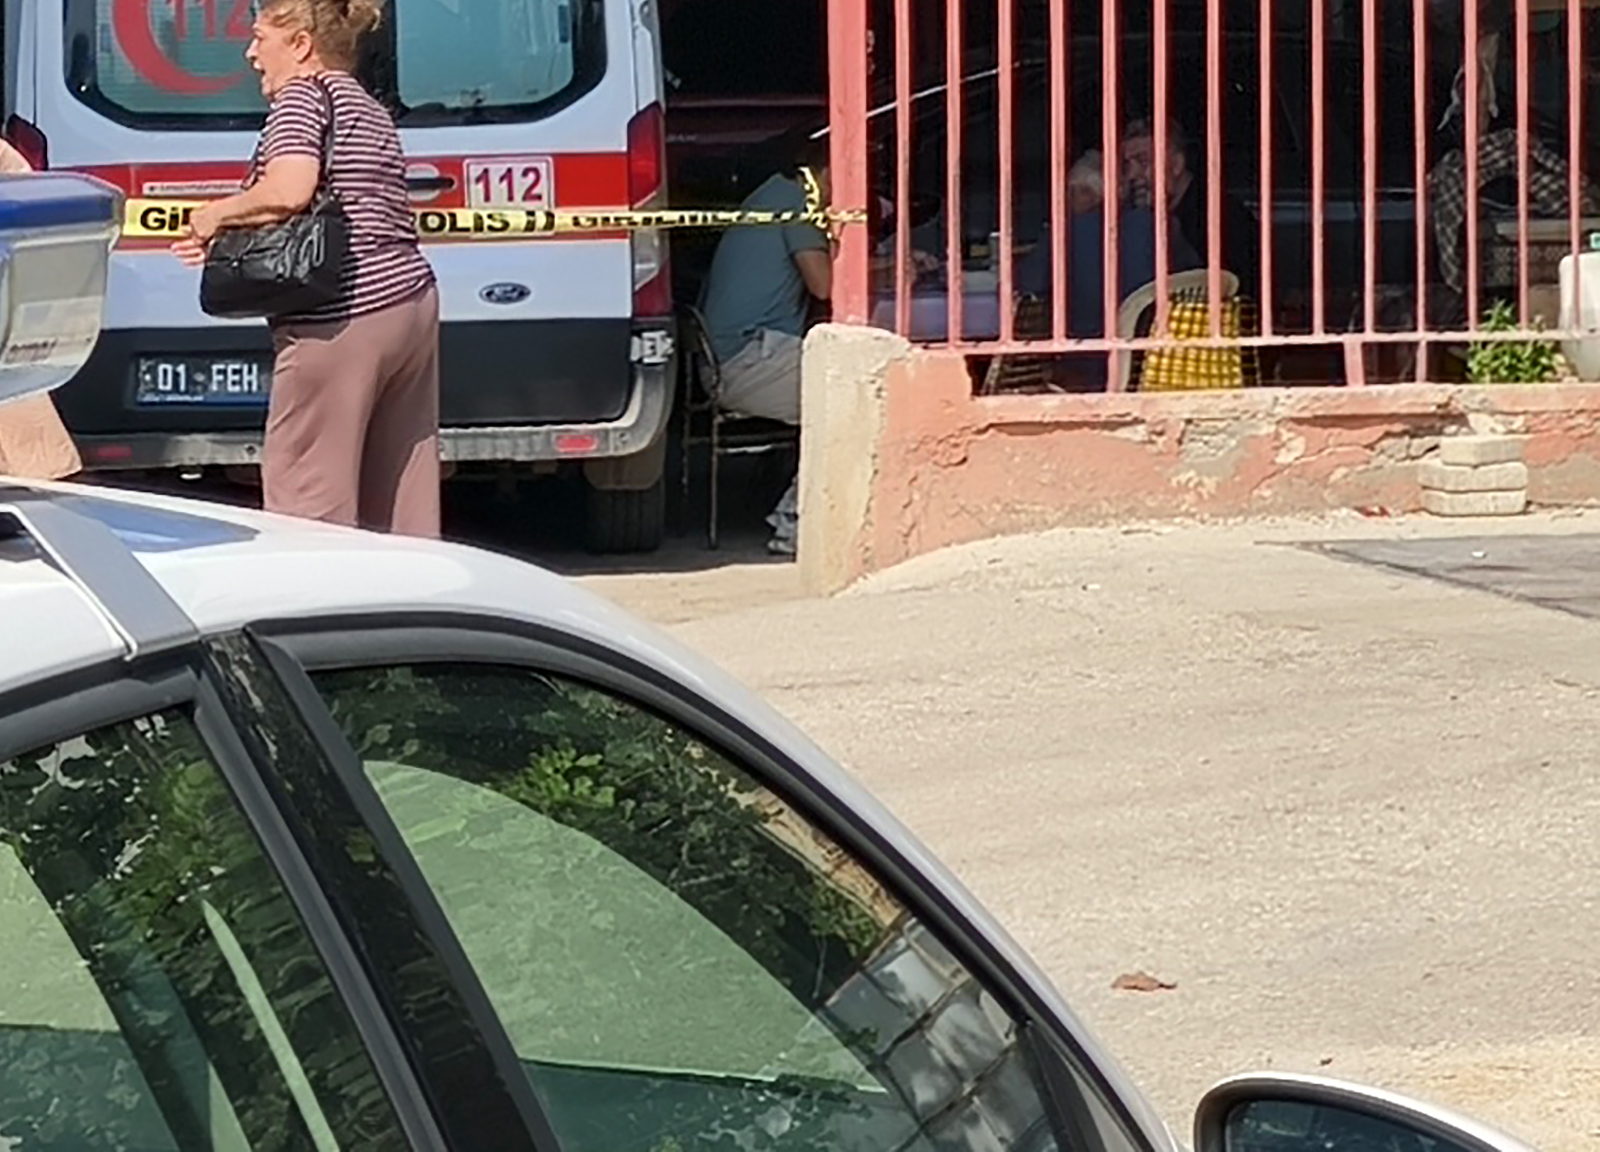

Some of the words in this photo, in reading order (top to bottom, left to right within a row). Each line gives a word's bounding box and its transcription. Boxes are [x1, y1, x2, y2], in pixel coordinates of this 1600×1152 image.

[474, 166, 543, 203] 112
[158, 363, 187, 392] 01
[210, 363, 259, 392] FEH
